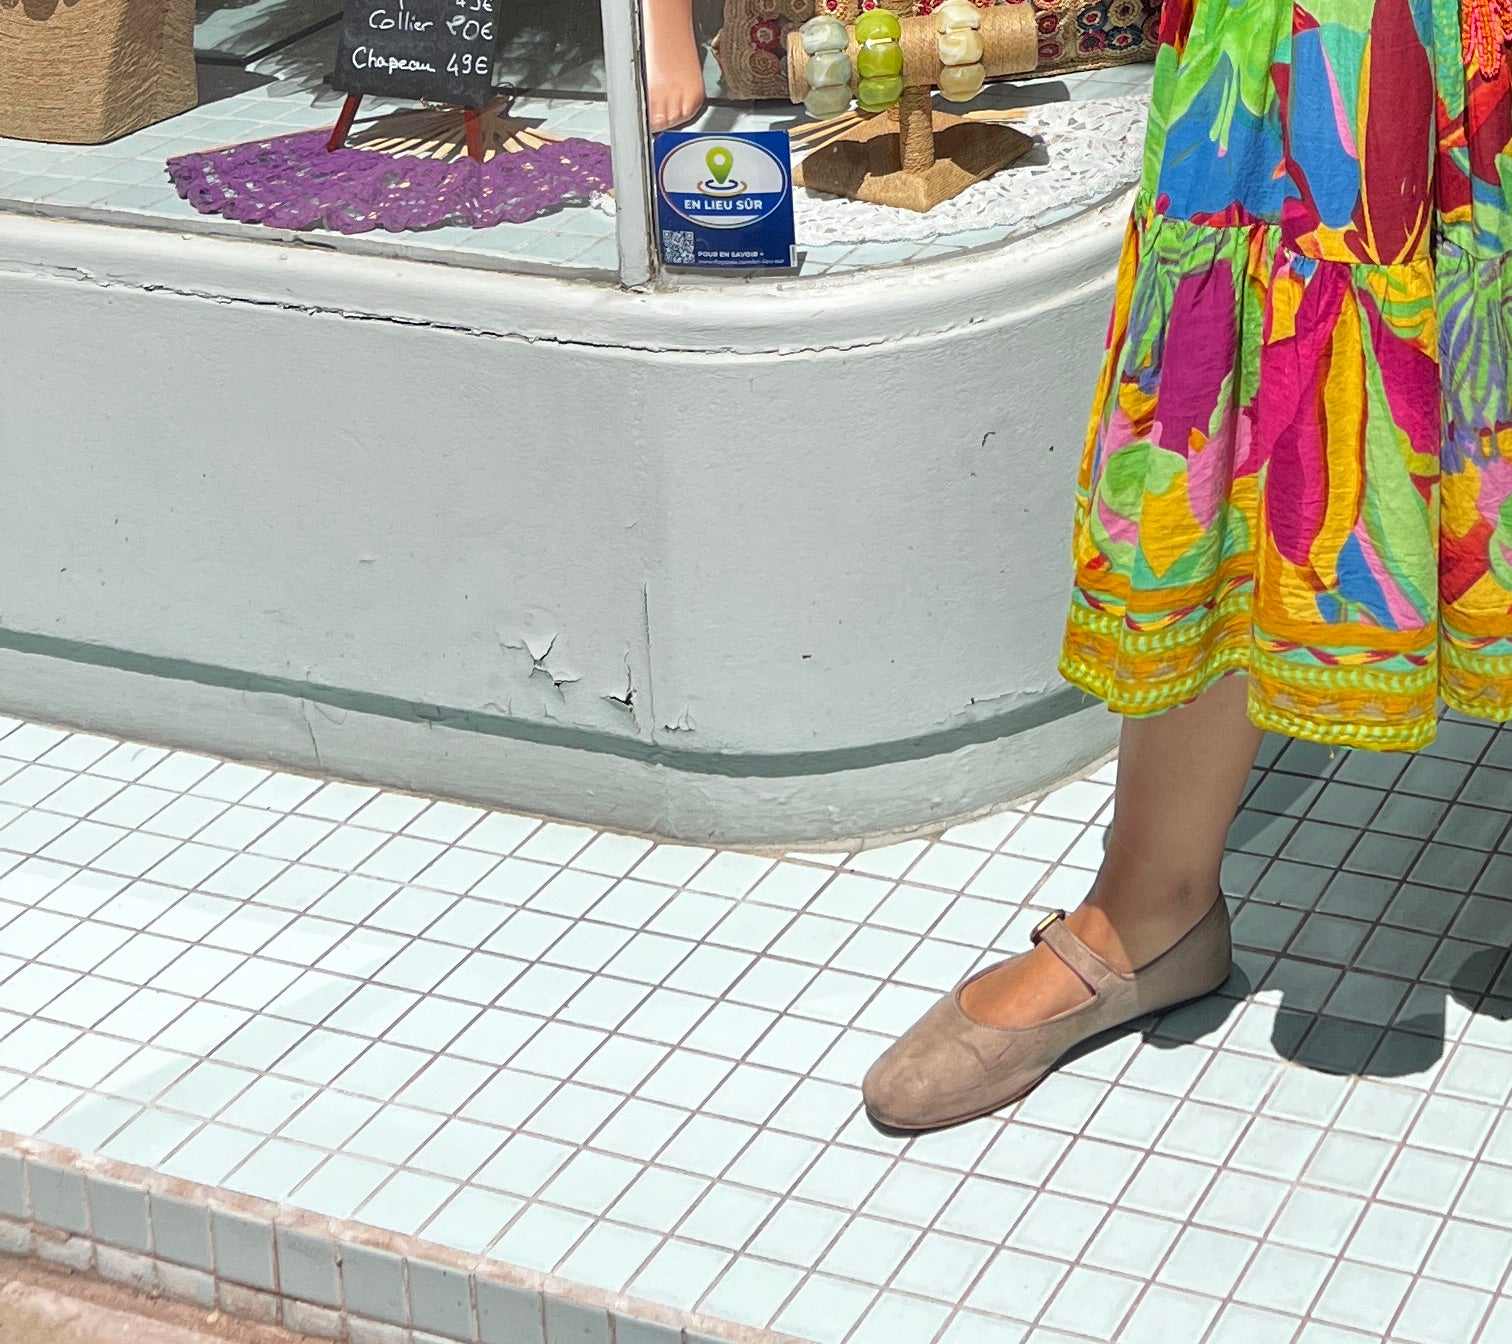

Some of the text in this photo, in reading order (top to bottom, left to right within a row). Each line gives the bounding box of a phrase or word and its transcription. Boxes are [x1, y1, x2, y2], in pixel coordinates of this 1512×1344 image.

[369, 9, 434, 32] Collier
[352, 46, 488, 77] Chapeau 49€
[684, 197, 763, 210] EN LIEU SÛR
